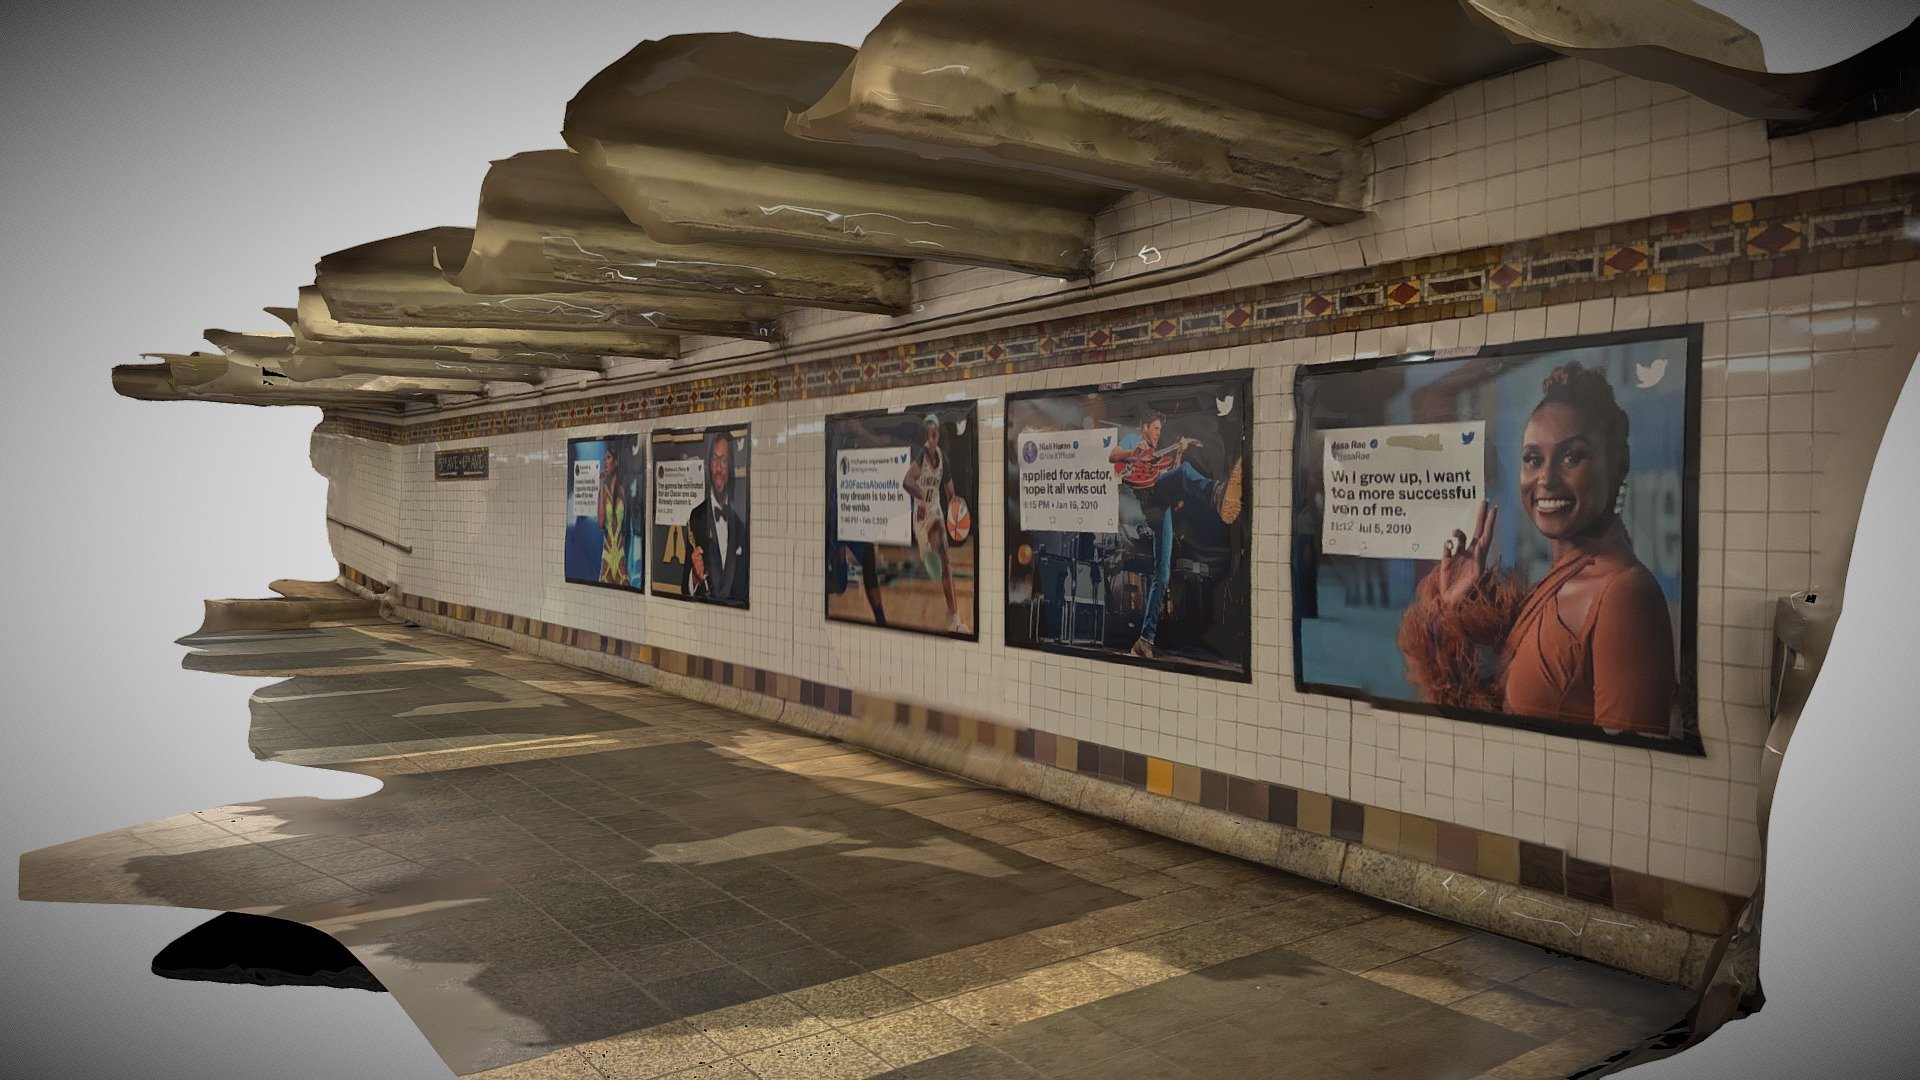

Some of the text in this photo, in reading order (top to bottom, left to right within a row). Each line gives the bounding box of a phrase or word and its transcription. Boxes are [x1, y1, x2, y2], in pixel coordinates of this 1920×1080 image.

[1351, 441, 1366, 449] Rae
[1023, 469, 1112, 483] applied for xfactor,
[1353, 471, 1356, 484] I
[1360, 473, 1396, 487] grow
[1400, 472, 1422, 486] up,
[1426, 470, 1430, 482] I
[1433, 469, 1471, 483] want
[840, 479, 900, 490] #30FactsAboutMe
[1046, 483, 1053, 494] it
[1055, 483, 1065, 494] all
[1067, 483, 1089, 494] wrks
[1090, 483, 1107, 495] out
[840, 491, 904, 502] my dream is to be in
[1359, 489, 1395, 500] more
[1399, 485, 1477, 500] successful
[840, 502, 871, 512] the wnba
[1038, 500, 1050, 509] PM
[1081, 500, 1098, 510] 2010
[1363, 503, 1377, 516] of
[1381, 505, 1407, 516] me.
[1374, 524, 1384, 536] 5,
[1386, 523, 1412, 535] 2010
